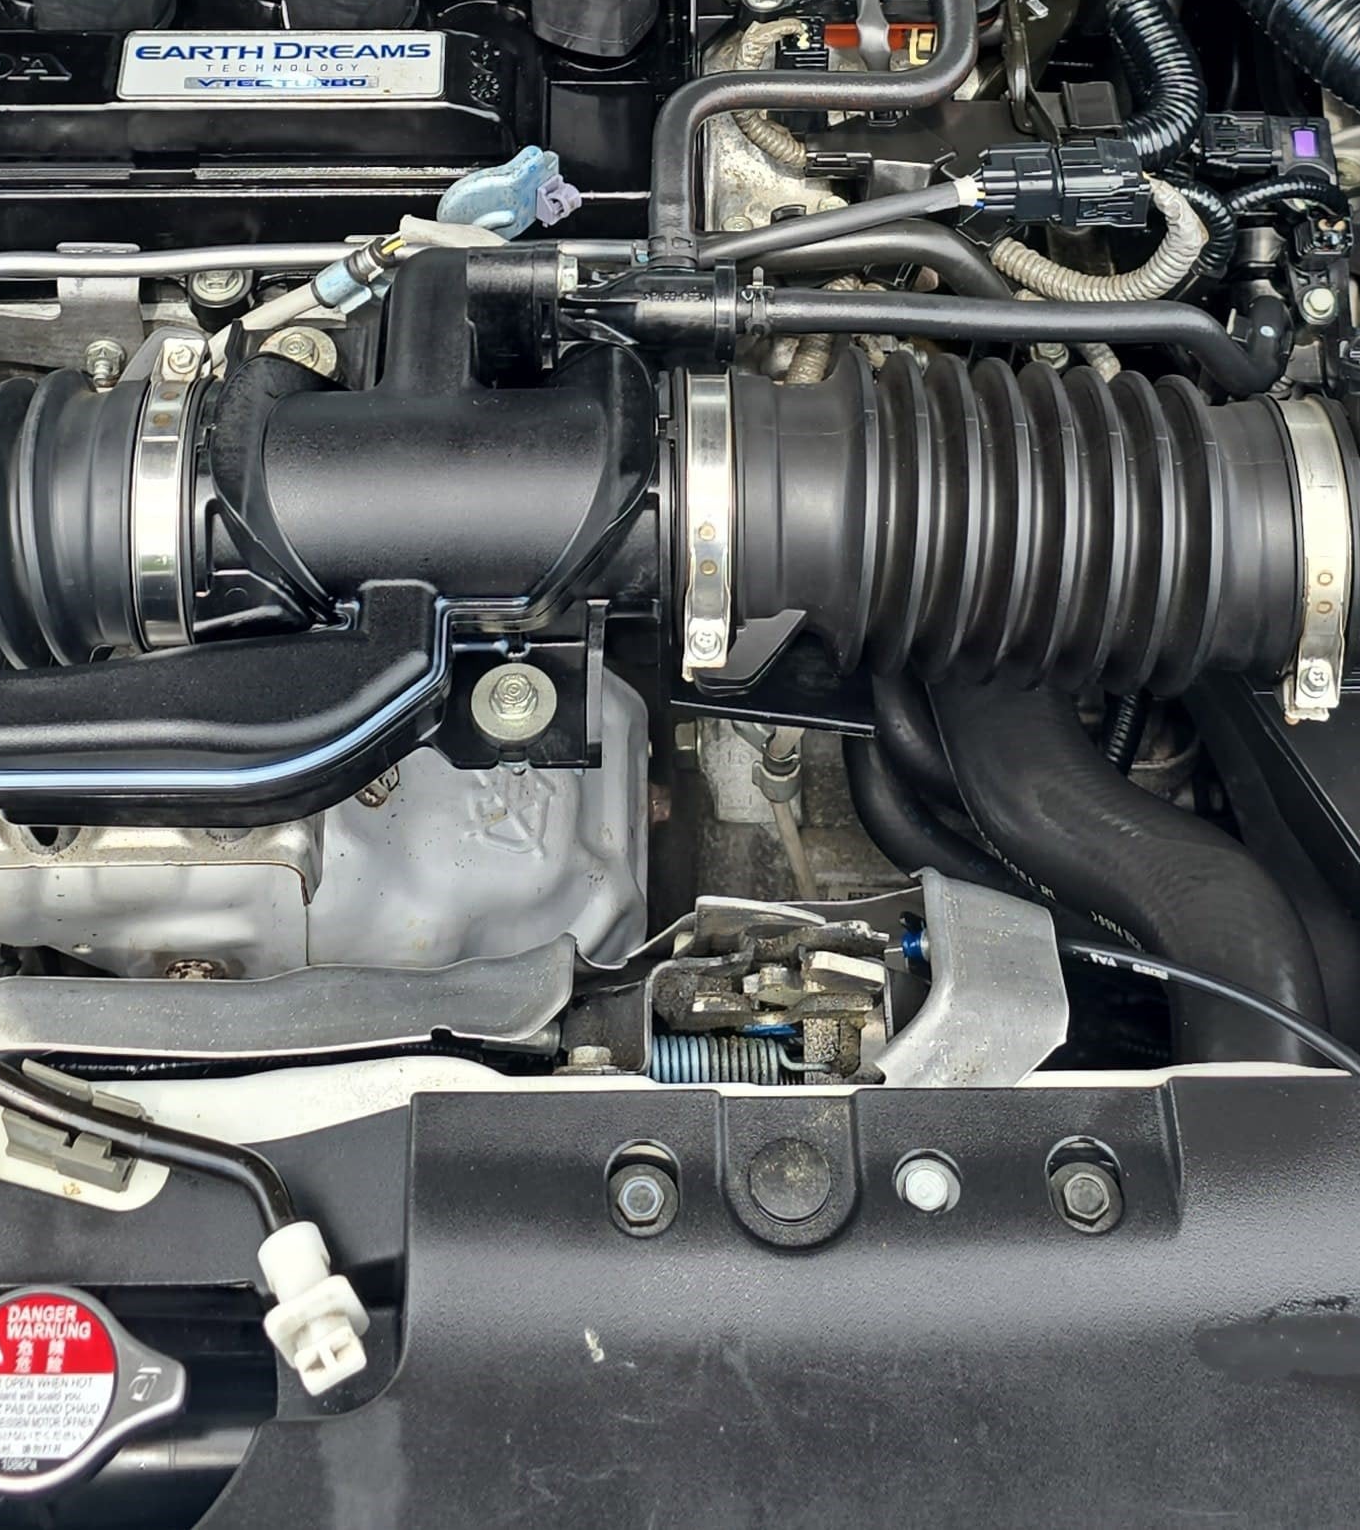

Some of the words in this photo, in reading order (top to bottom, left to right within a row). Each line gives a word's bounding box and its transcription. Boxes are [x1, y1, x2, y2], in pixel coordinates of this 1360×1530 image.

[135, 45, 264, 61] EARTH
[273, 41, 432, 59] DREAMS
[206, 63, 360, 73] TECHNOLOGY
[197, 78, 272, 88] VTEC
[7, 1304, 78, 1321] DANGER
[6, 1321, 92, 1340] WARNUNG
[4, 1377, 34, 1389] OPEN
[37, 1377, 69, 1389] WHEN
[70, 1377, 94, 1389] HOT
